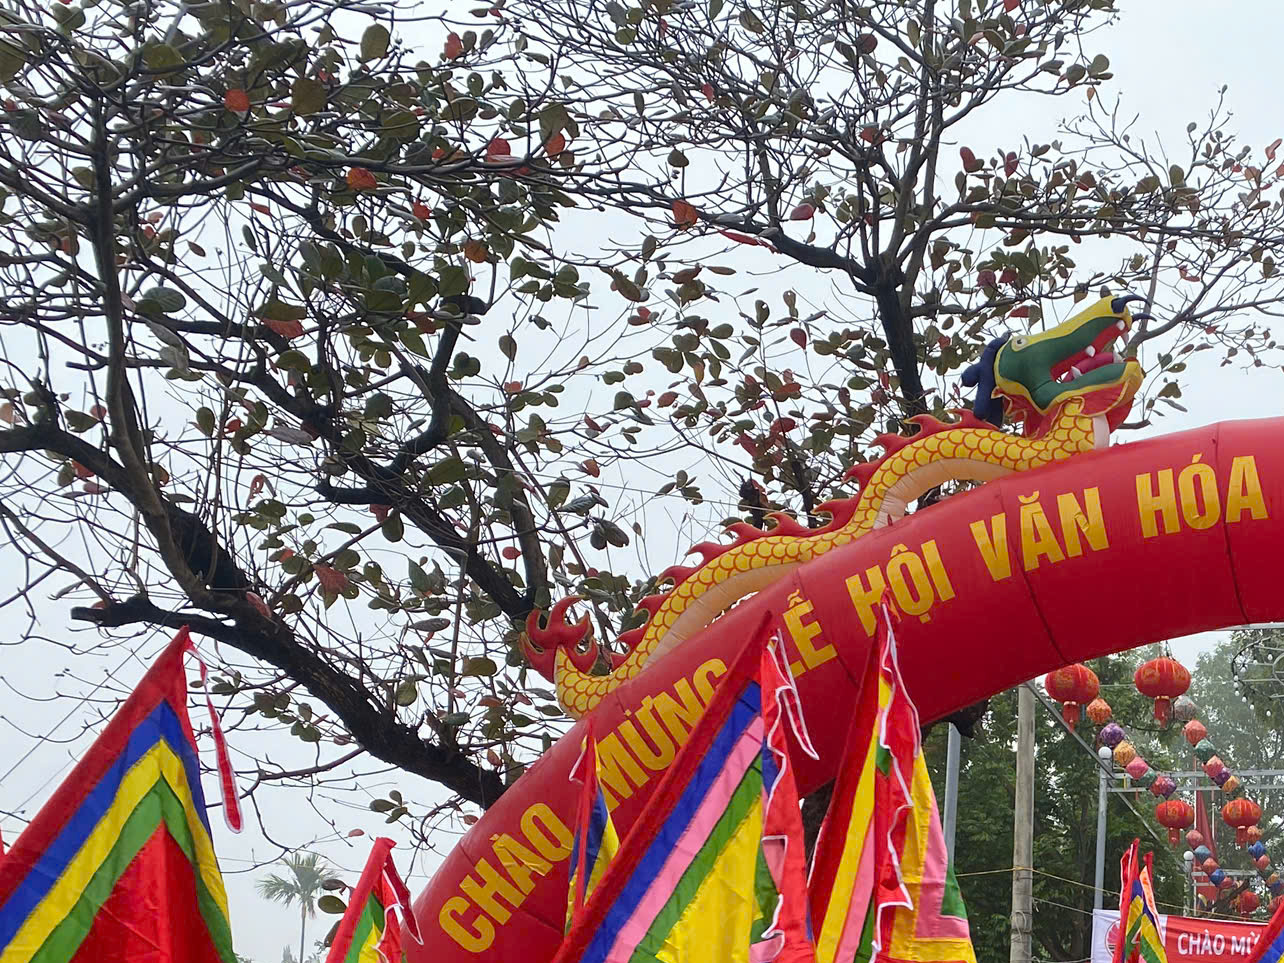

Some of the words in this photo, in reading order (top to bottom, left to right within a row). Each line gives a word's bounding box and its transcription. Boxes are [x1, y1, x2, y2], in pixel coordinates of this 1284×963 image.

[438, 802, 575, 953] CHÀO
[786, 588, 838, 679] Ễ
[845, 543, 956, 637] HỘI
[969, 486, 1110, 582] VĂN
[1135, 453, 1268, 539] HÓA
[1177, 929, 1225, 956] CHÀO
